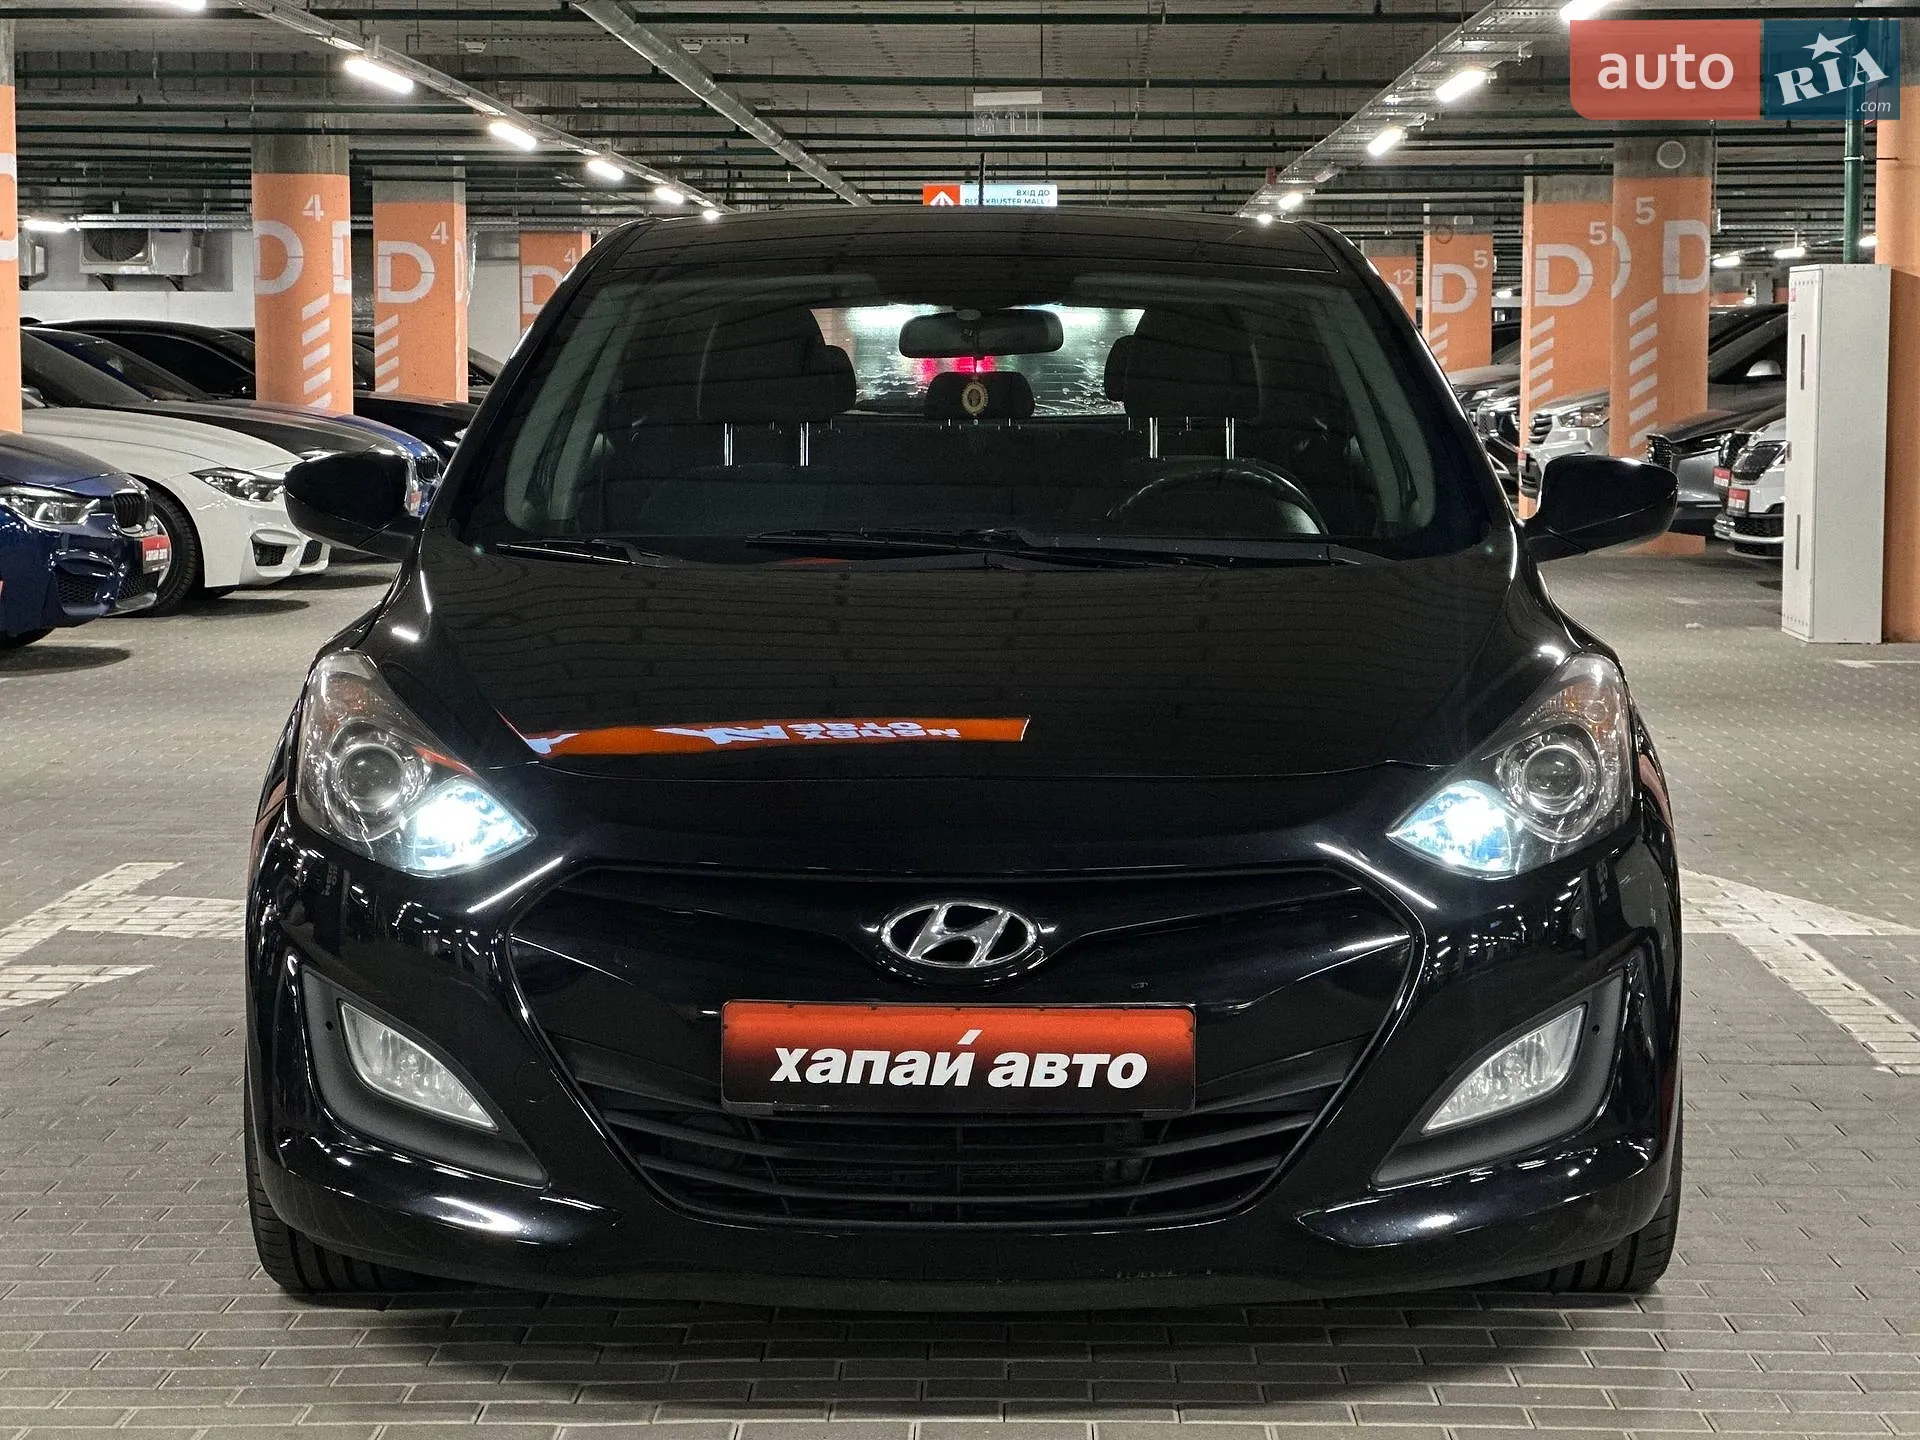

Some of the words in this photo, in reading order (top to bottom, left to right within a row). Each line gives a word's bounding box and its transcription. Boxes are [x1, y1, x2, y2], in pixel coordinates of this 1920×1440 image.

[302, 194, 325, 222] 4
[377, 240, 435, 303] D
[430, 221, 449, 245] 4
[1535, 243, 1593, 307] D
[1589, 221, 1608, 246] 5
[1634, 196, 1656, 225] 5
[1662, 219, 1711, 294] D
[1393, 269, 1415, 285] 12
[1432, 263, 1477, 313] D
[1473, 250, 1488, 268] 5
[769, 1029, 983, 1086] хапай
[986, 1050, 1149, 1089] авто
